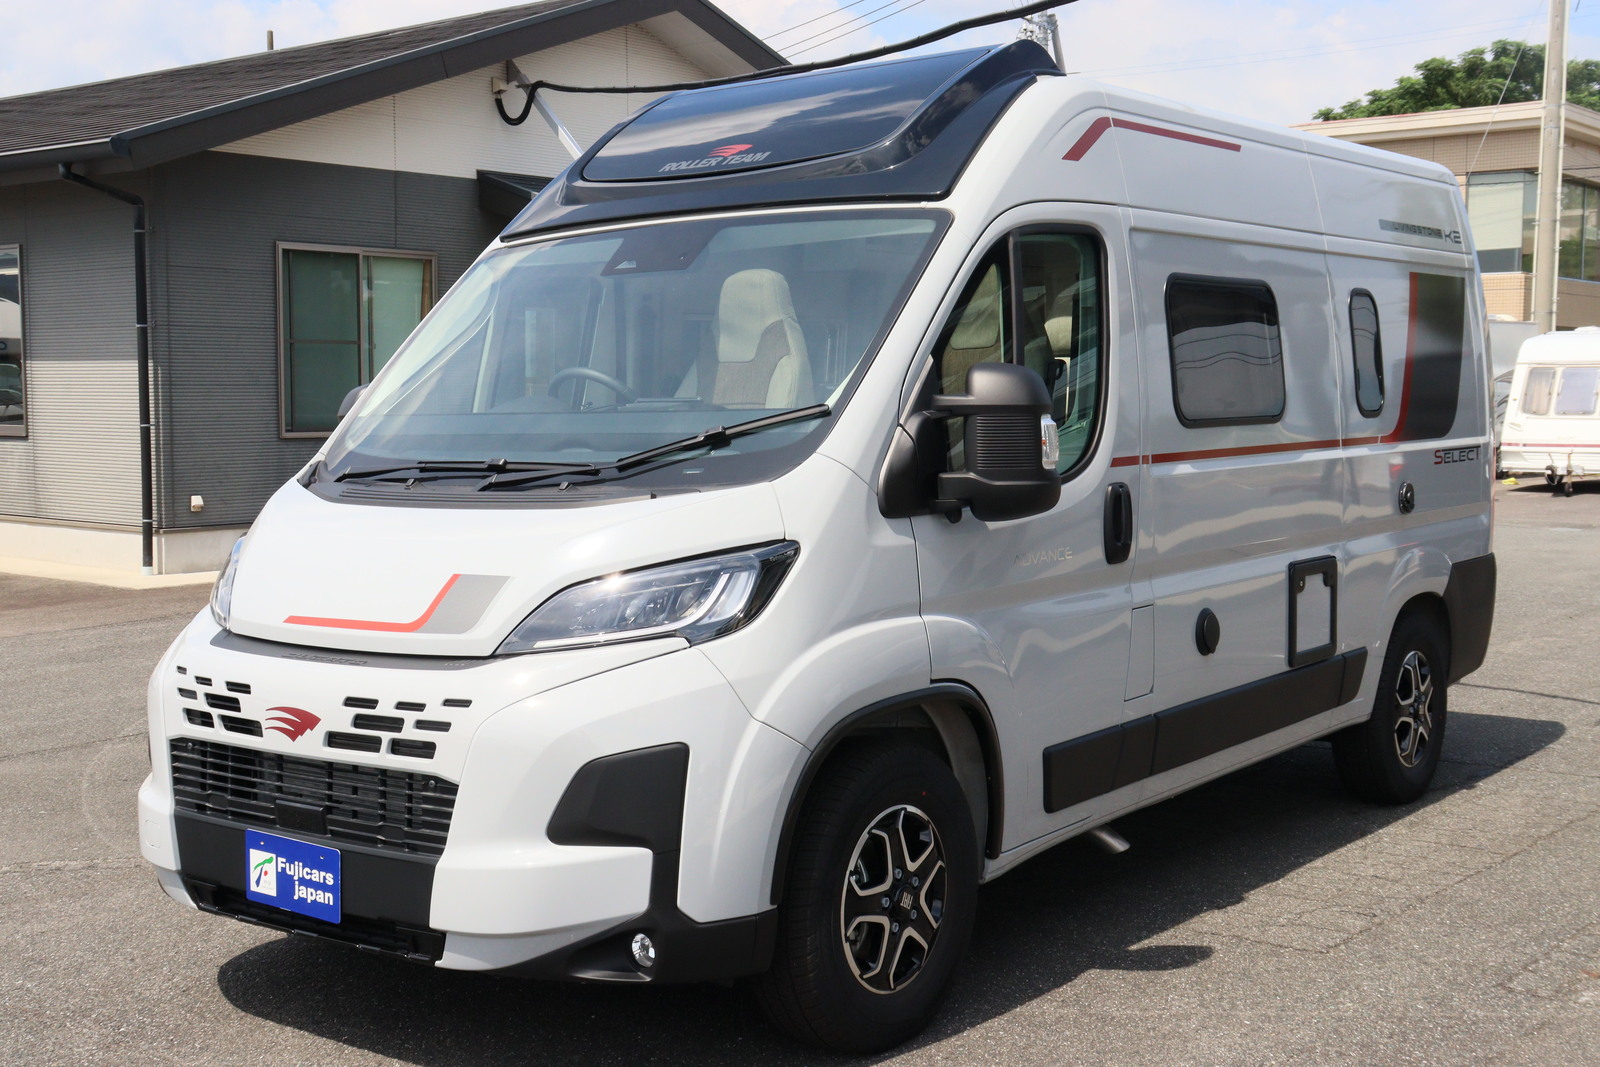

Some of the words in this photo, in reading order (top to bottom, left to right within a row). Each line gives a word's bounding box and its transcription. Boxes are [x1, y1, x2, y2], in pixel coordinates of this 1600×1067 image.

[658, 156, 723, 172] ROLLER
[722, 151, 772, 165] TEAM
[277, 856, 334, 886] Fujicars
[293, 880, 334, 906] japan
